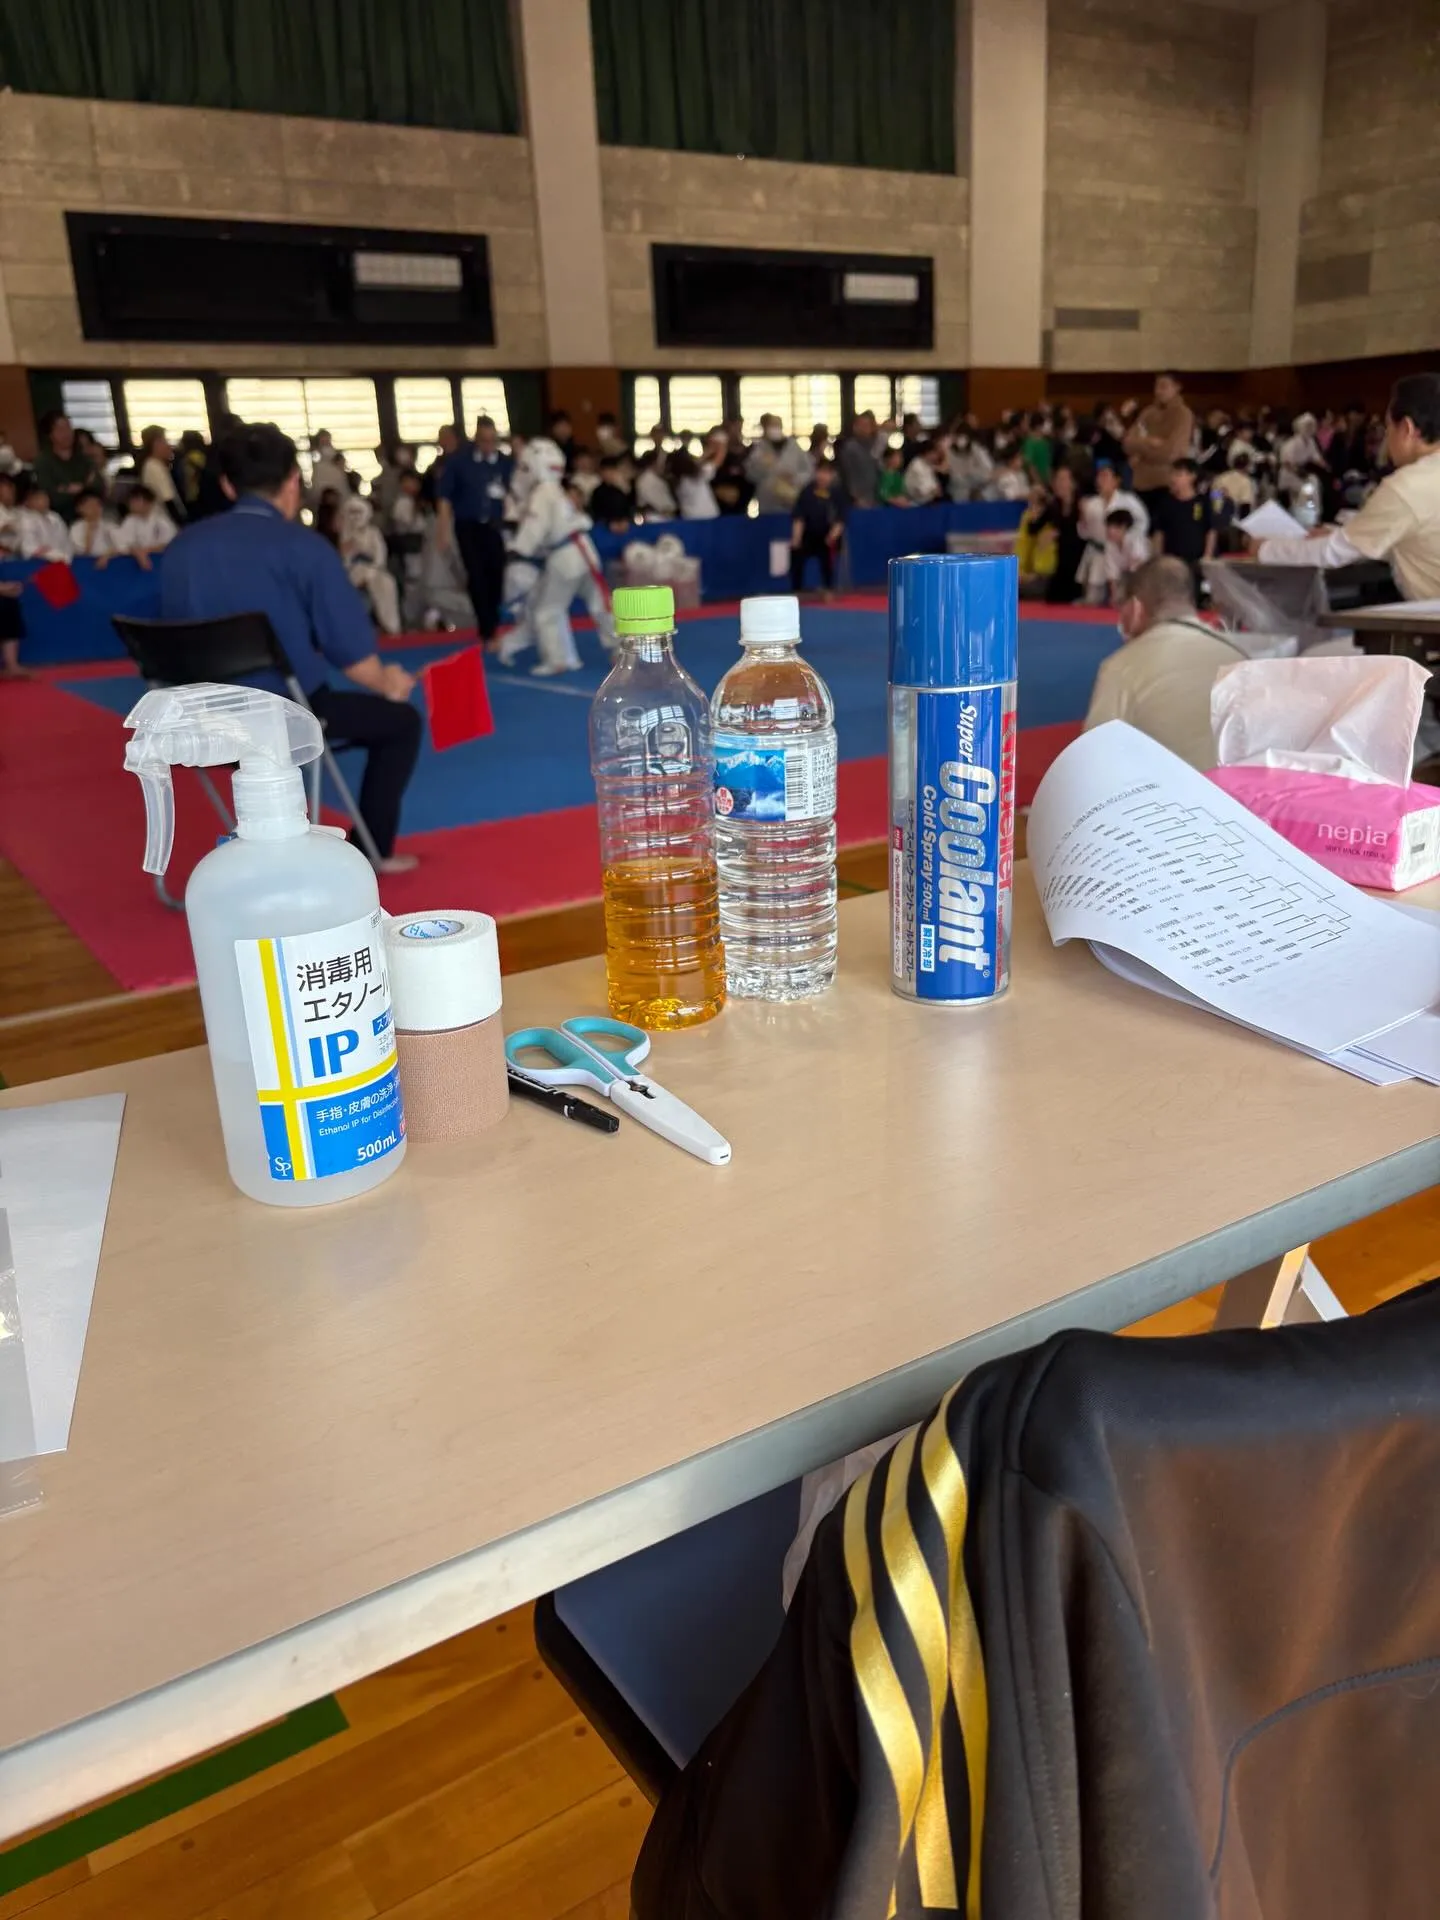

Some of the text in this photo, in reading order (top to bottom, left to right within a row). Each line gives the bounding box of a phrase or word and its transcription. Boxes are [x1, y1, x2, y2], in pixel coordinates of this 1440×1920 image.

[957, 700, 977, 763] Super
[922, 785, 938, 832] Cold
[920, 830, 937, 882] Spray
[1317, 822, 1388, 847] nepia
[939, 761, 997, 970] Coolant
[296, 946, 373, 992] 消毒用
[922, 926, 934, 970] 瞬間冷却
[303, 967, 389, 1023] エタノール
[308, 1029, 360, 1079] IP
[318, 1122, 350, 1137] Ethanol
[351, 1118, 361, 1129] IP
[361, 1114, 373, 1124] for
[357, 1130, 398, 1161] 500mL
